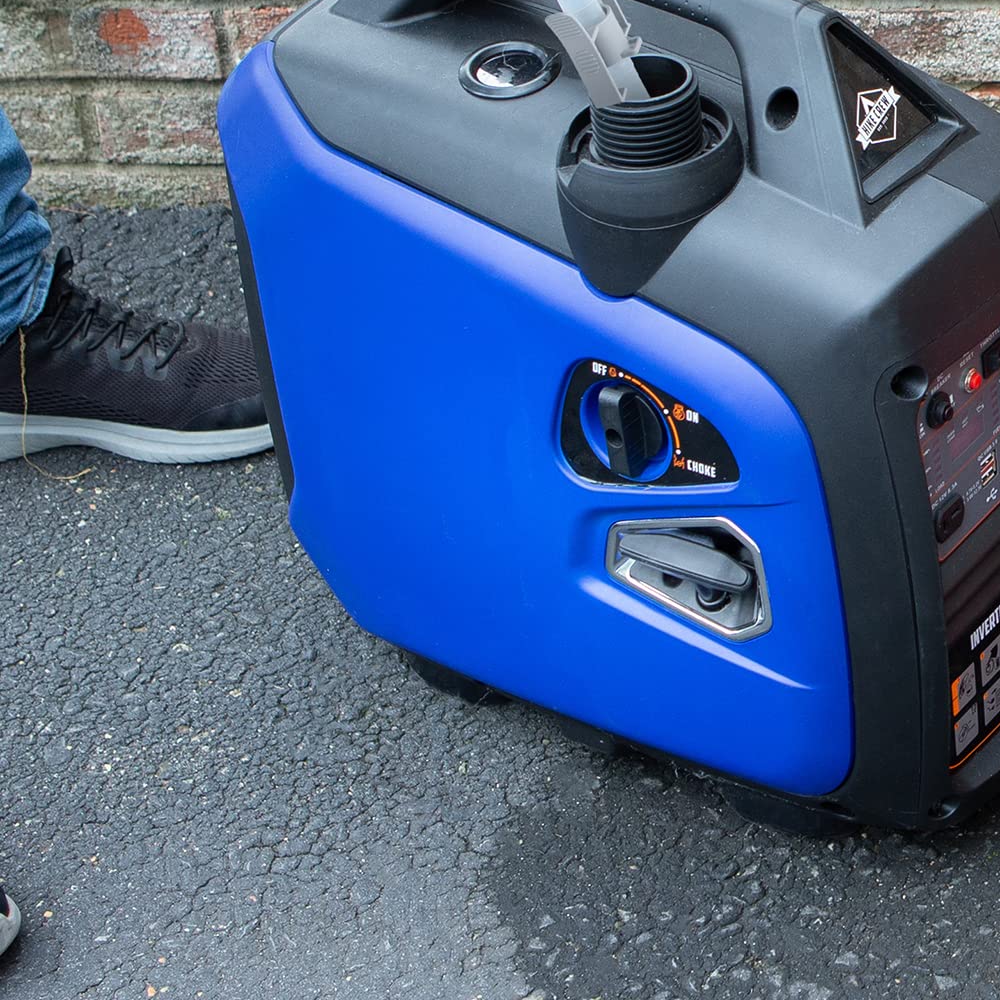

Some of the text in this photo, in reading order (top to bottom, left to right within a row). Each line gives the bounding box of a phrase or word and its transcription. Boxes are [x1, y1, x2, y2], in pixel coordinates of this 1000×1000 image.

[861, 114, 877, 136] HIKE
[873, 95, 890, 119] CREW
[592, 361, 608, 376] OFF
[686, 409, 699, 424] ON
[686, 459, 717, 478] CHOKE
